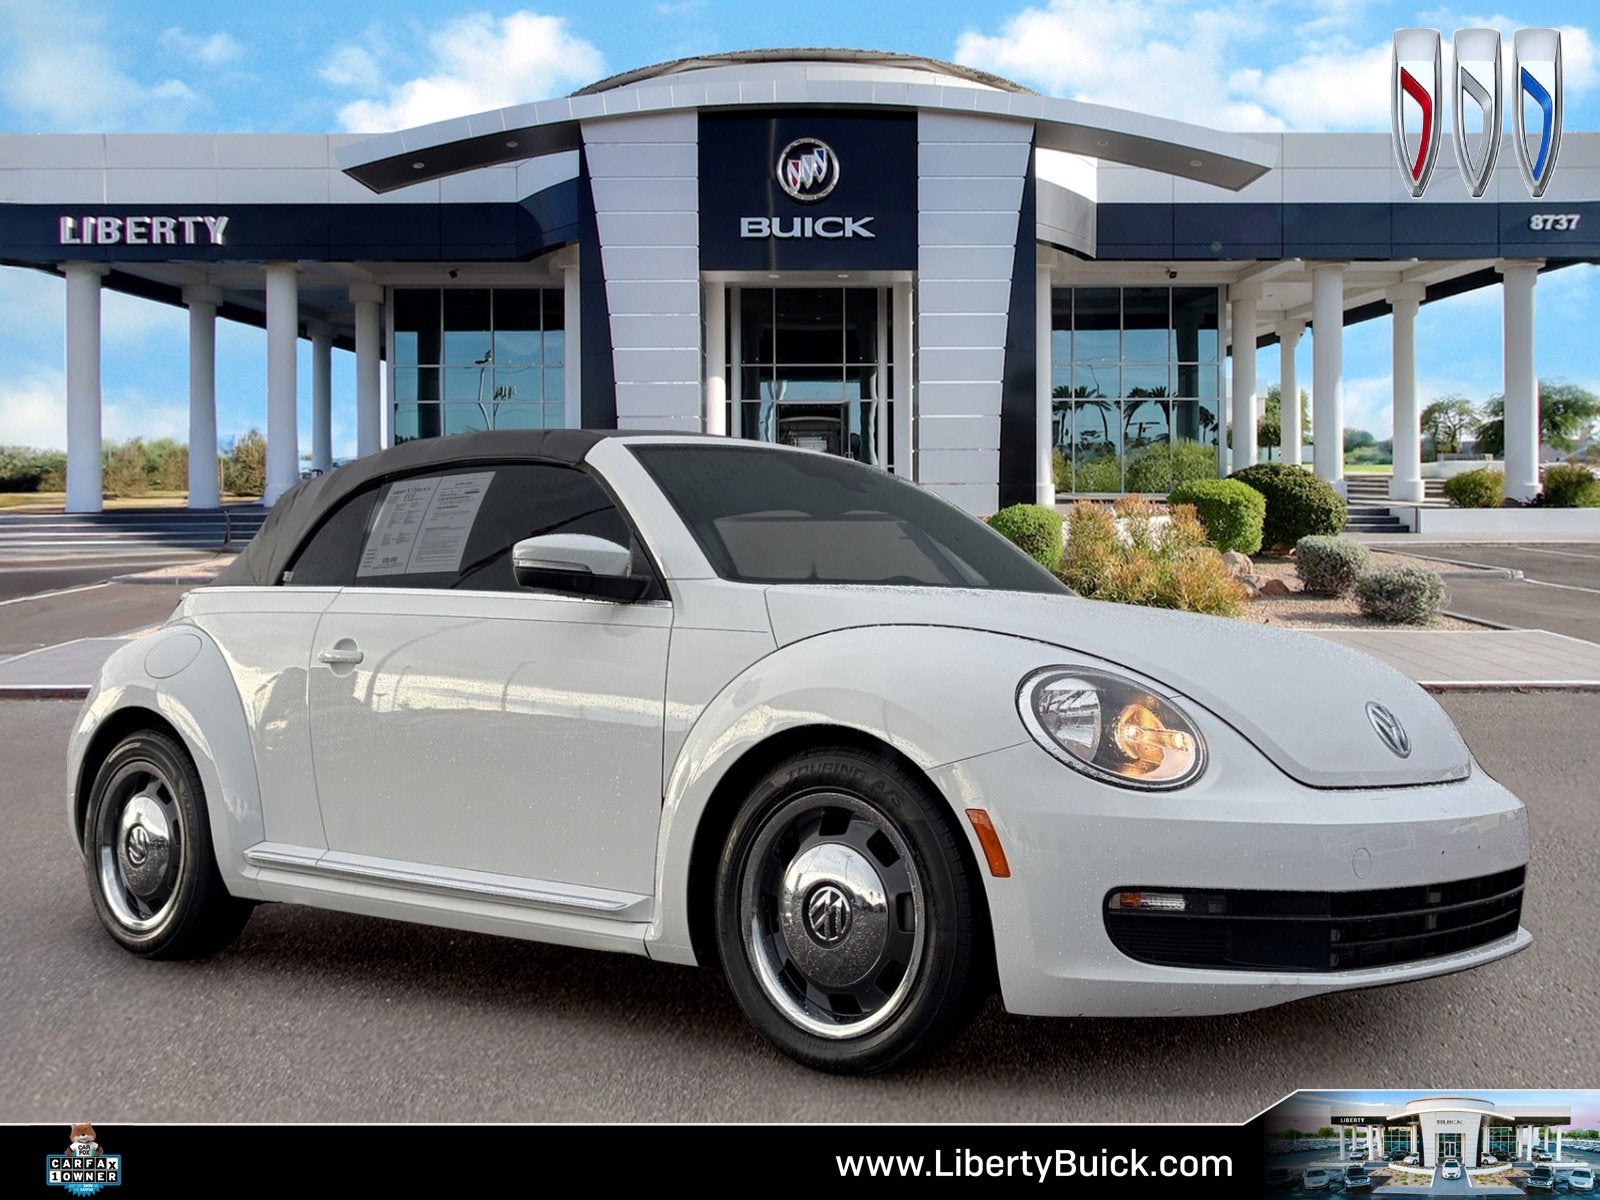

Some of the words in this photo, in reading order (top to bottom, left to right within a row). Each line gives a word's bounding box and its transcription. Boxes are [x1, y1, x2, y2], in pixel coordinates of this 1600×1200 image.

[59, 215, 229, 245] LIBERTY
[740, 216, 876, 238] BUICK
[1529, 214, 1581, 231] 8737
